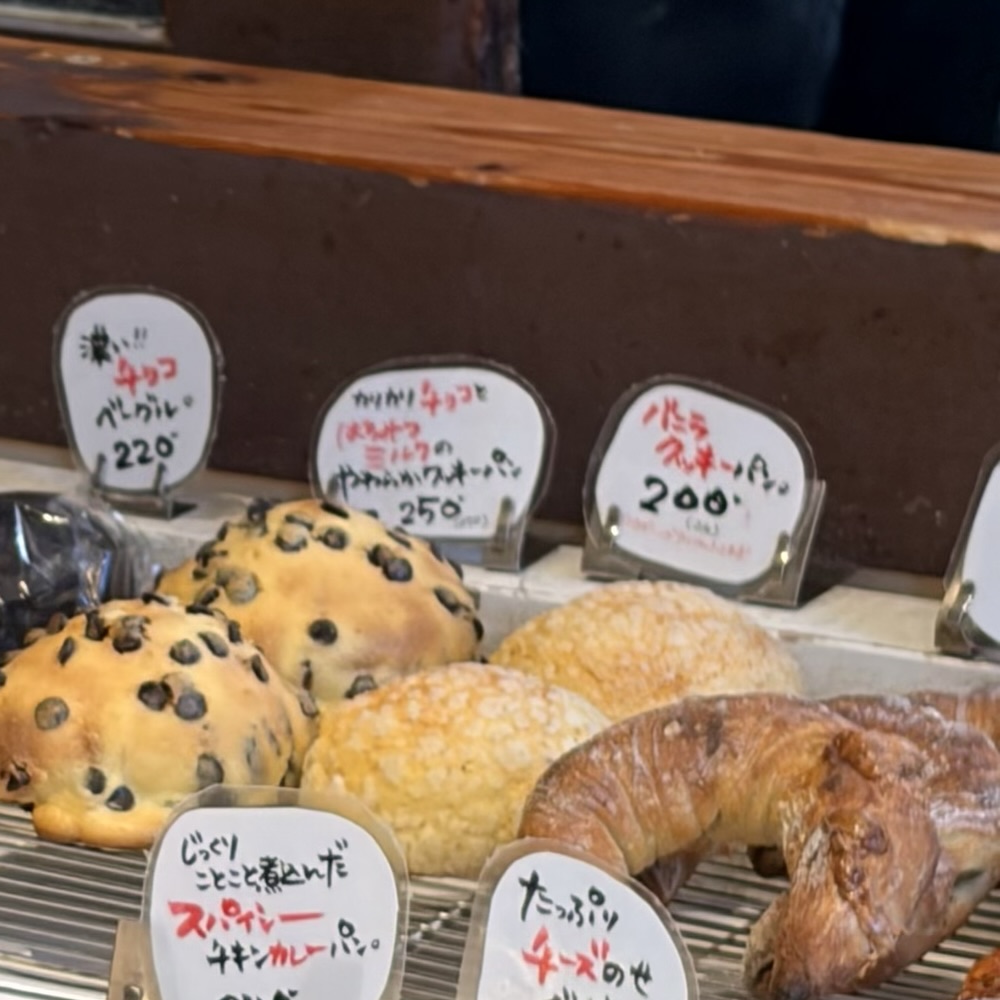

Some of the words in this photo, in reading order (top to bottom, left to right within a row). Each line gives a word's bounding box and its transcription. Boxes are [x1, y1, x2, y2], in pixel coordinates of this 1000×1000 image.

[181, 829, 239, 866] じっくり
[167, 896, 325, 940] スパイシー
[517, 868, 620, 932] たっぷり
[520, 924, 654, 999] チーズのせ
